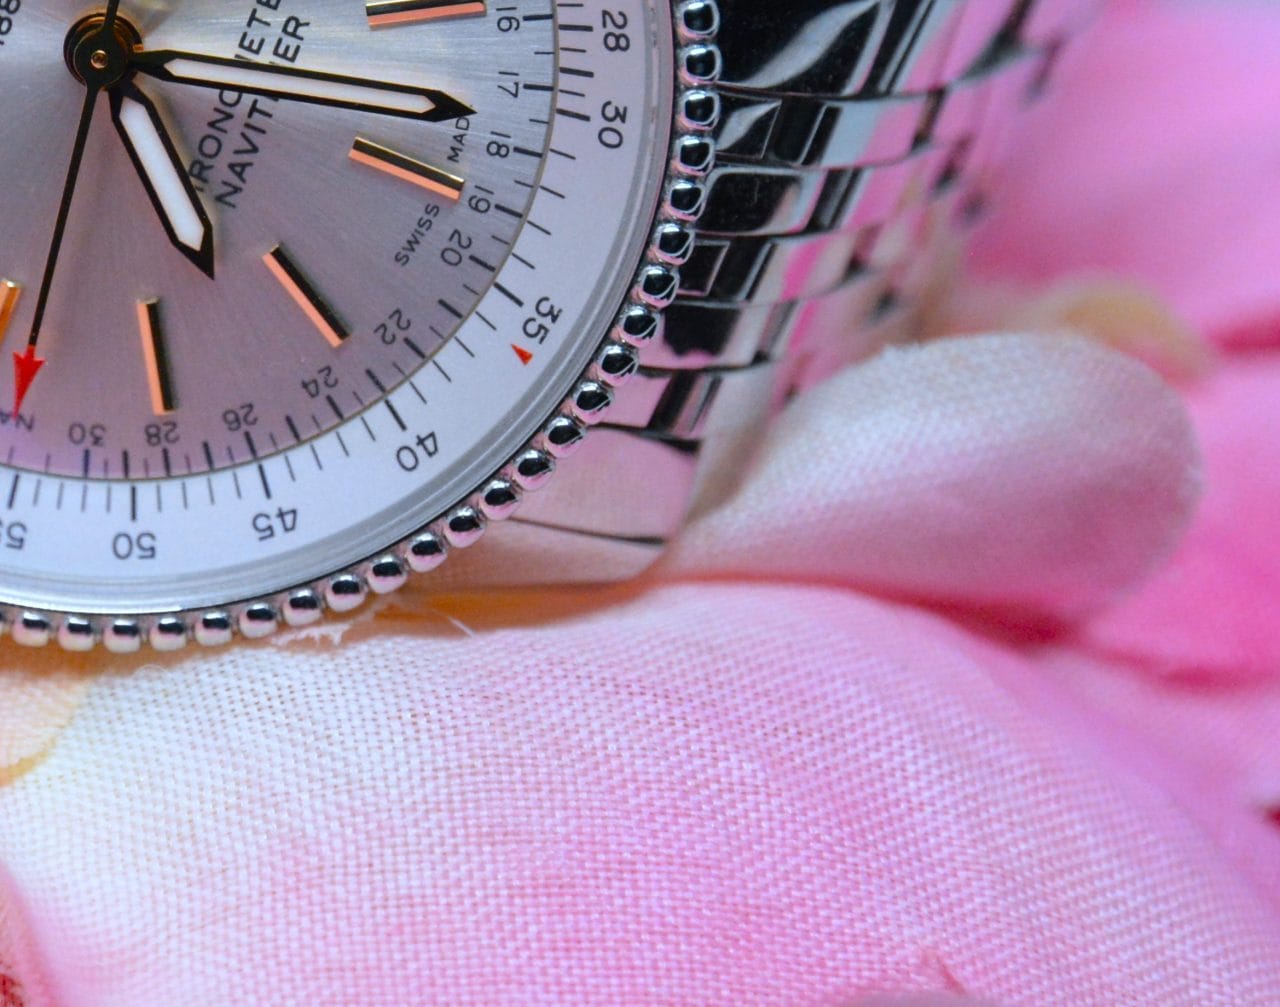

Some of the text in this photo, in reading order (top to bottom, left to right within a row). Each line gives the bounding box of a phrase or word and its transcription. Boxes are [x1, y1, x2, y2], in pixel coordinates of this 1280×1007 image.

[496, 7, 520, 32] 16
[601, 10, 630, 52] 28
[497, 71, 519, 98] 17
[214, 14, 311, 209] NAVITER
[598, 101, 627, 149] 30
[486, 131, 511, 158] 18
[394, 114, 471, 266] SWISS MAD
[468, 185, 494, 213] 19
[440, 229, 472, 267] 20
[374, 309, 411, 345] 22
[521, 296, 563, 344] 35
[302, 365, 339, 399] 24
[144, 421, 180, 446] 28
[222, 403, 258, 431] 26
[69, 423, 106, 446] 30
[395, 431, 440, 472] 40
[252, 507, 298, 541] 45
[112, 532, 157, 560] 50
